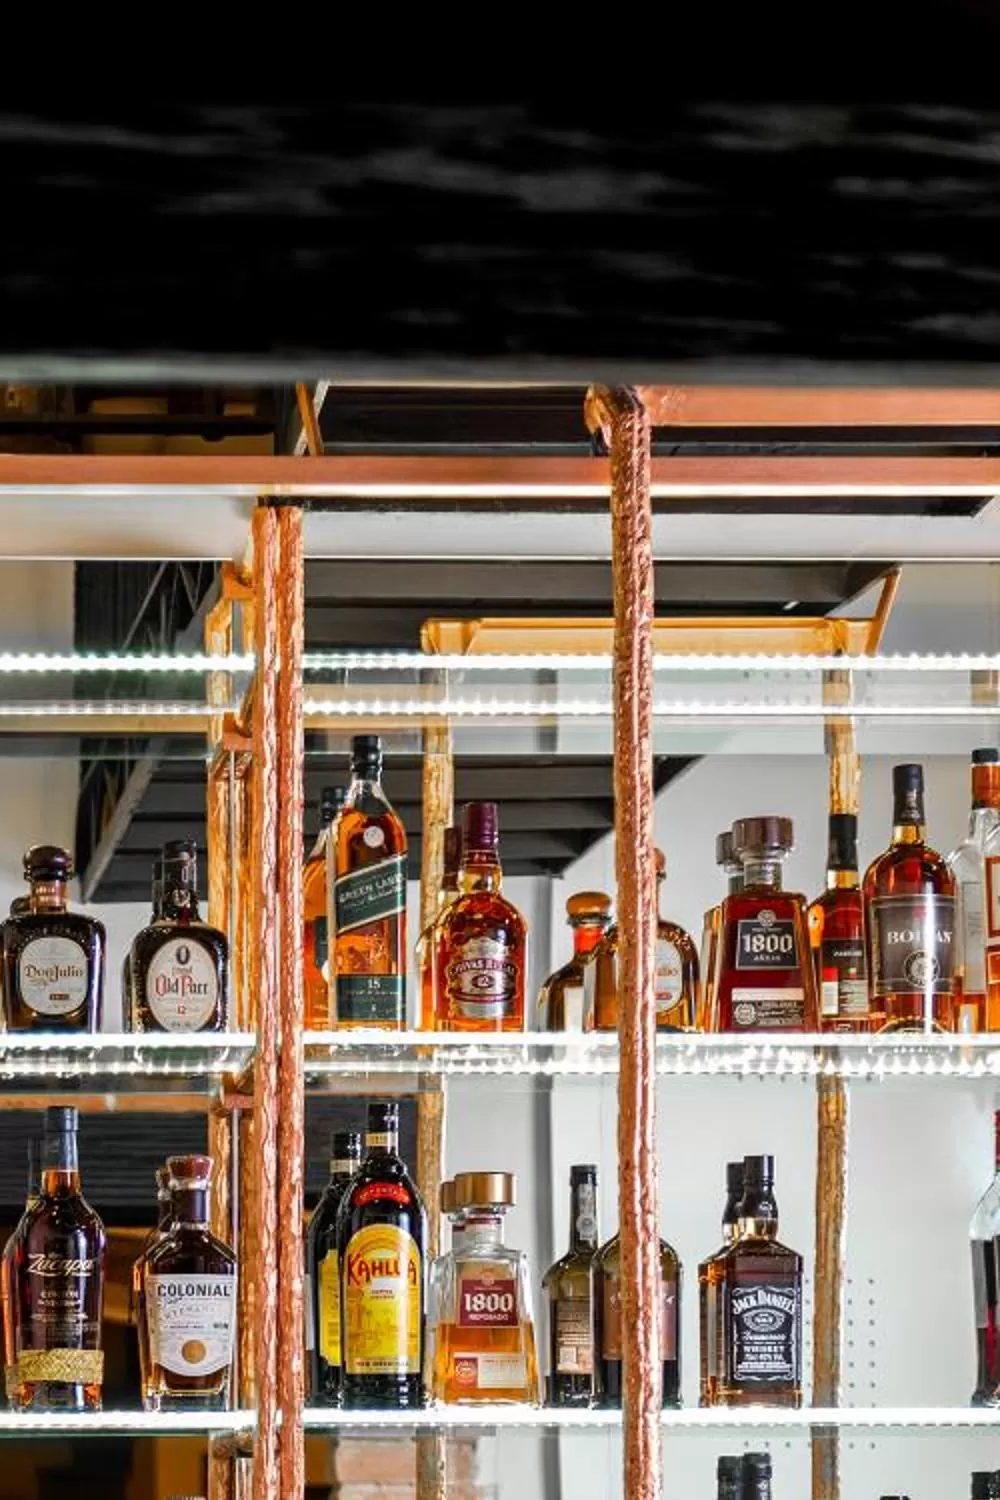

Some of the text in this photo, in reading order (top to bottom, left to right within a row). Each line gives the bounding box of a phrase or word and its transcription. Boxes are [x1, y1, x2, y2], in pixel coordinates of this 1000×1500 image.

[742, 933, 793, 953] 1800
[887, 930, 953, 945] BOTAN
[154, 973, 208, 997] Old Parr
[157, 1282, 231, 1298] COLONIAL
[463, 1292, 512, 1312] 1800
[732, 1294, 755, 1315] JACK
